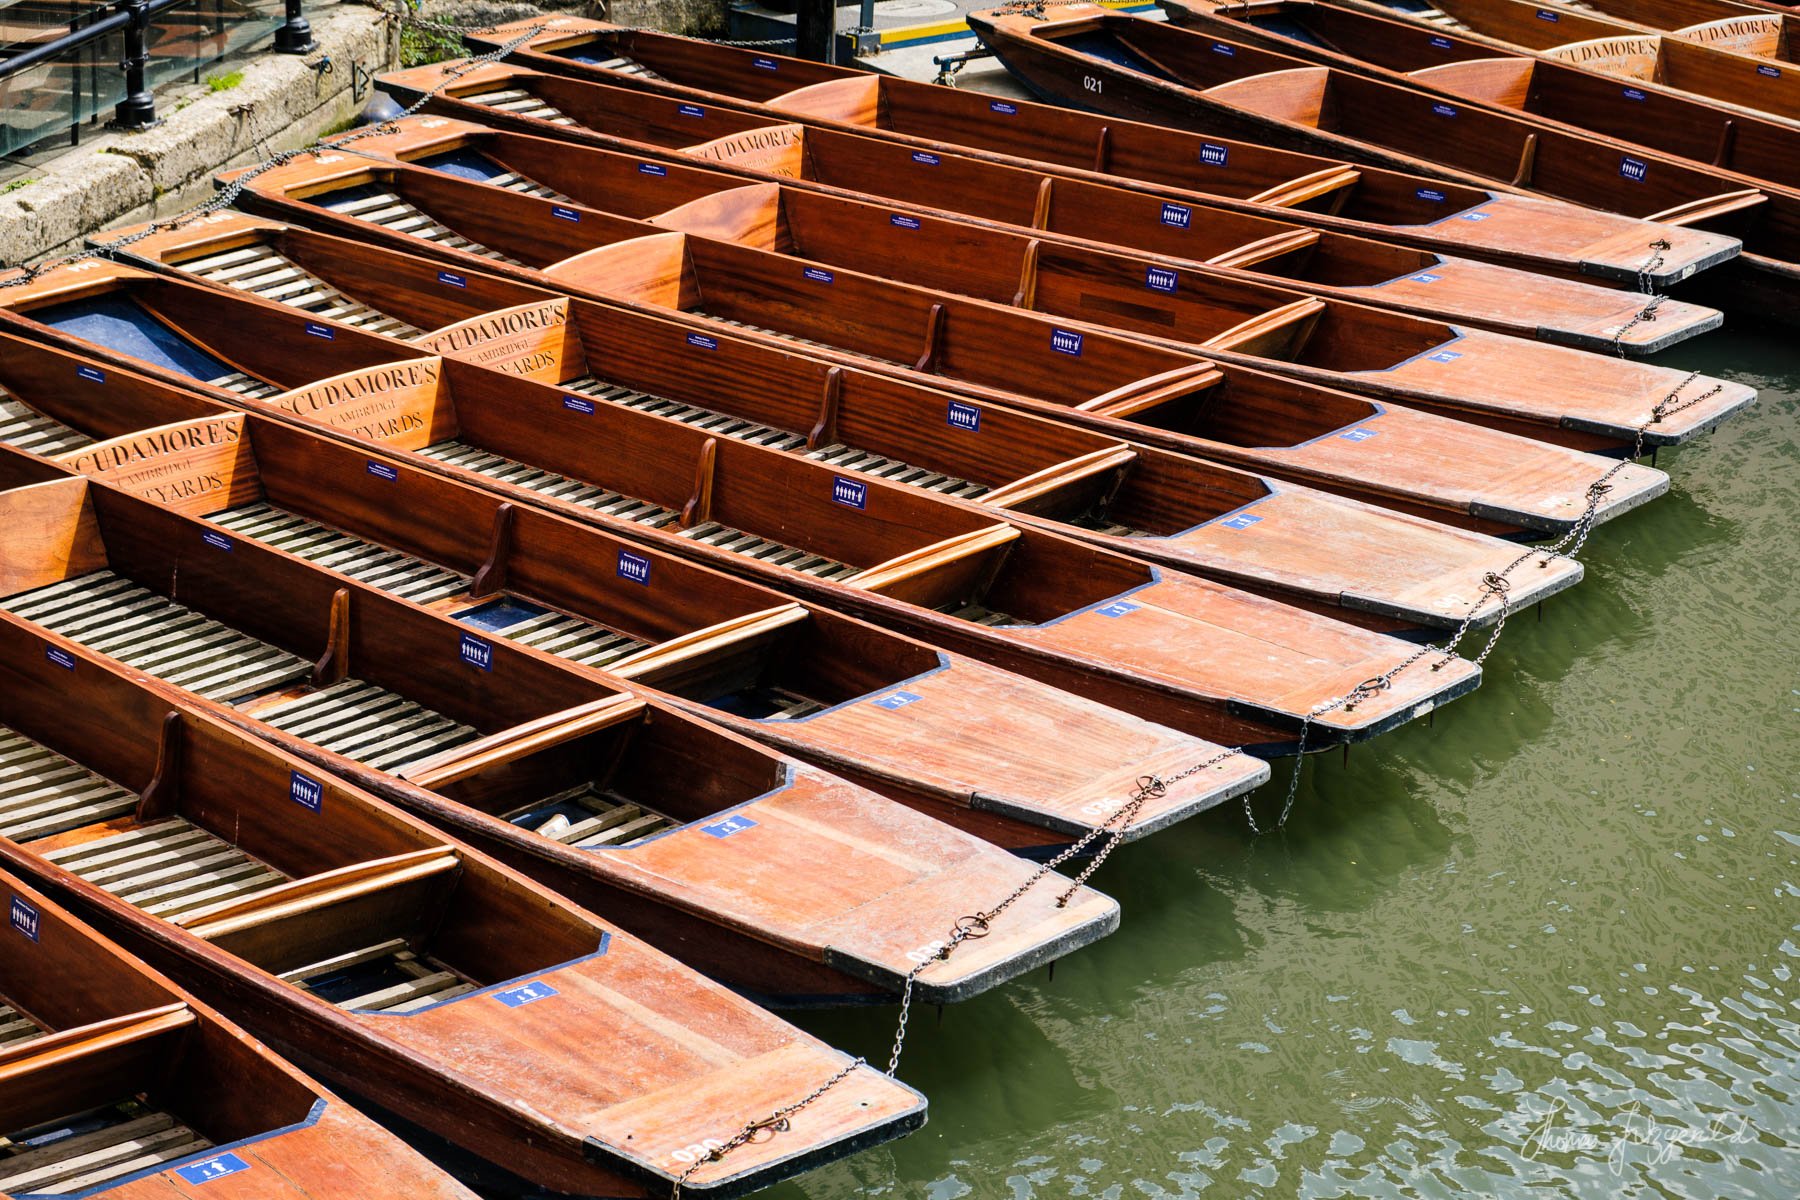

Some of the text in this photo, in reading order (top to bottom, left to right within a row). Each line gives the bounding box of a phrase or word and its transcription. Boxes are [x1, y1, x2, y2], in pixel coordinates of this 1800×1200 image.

[1686, 18, 1780, 41] CUDAMORE'S
[1557, 40, 1657, 62] CUDAMORE'S
[1084, 75, 1101, 94] 021
